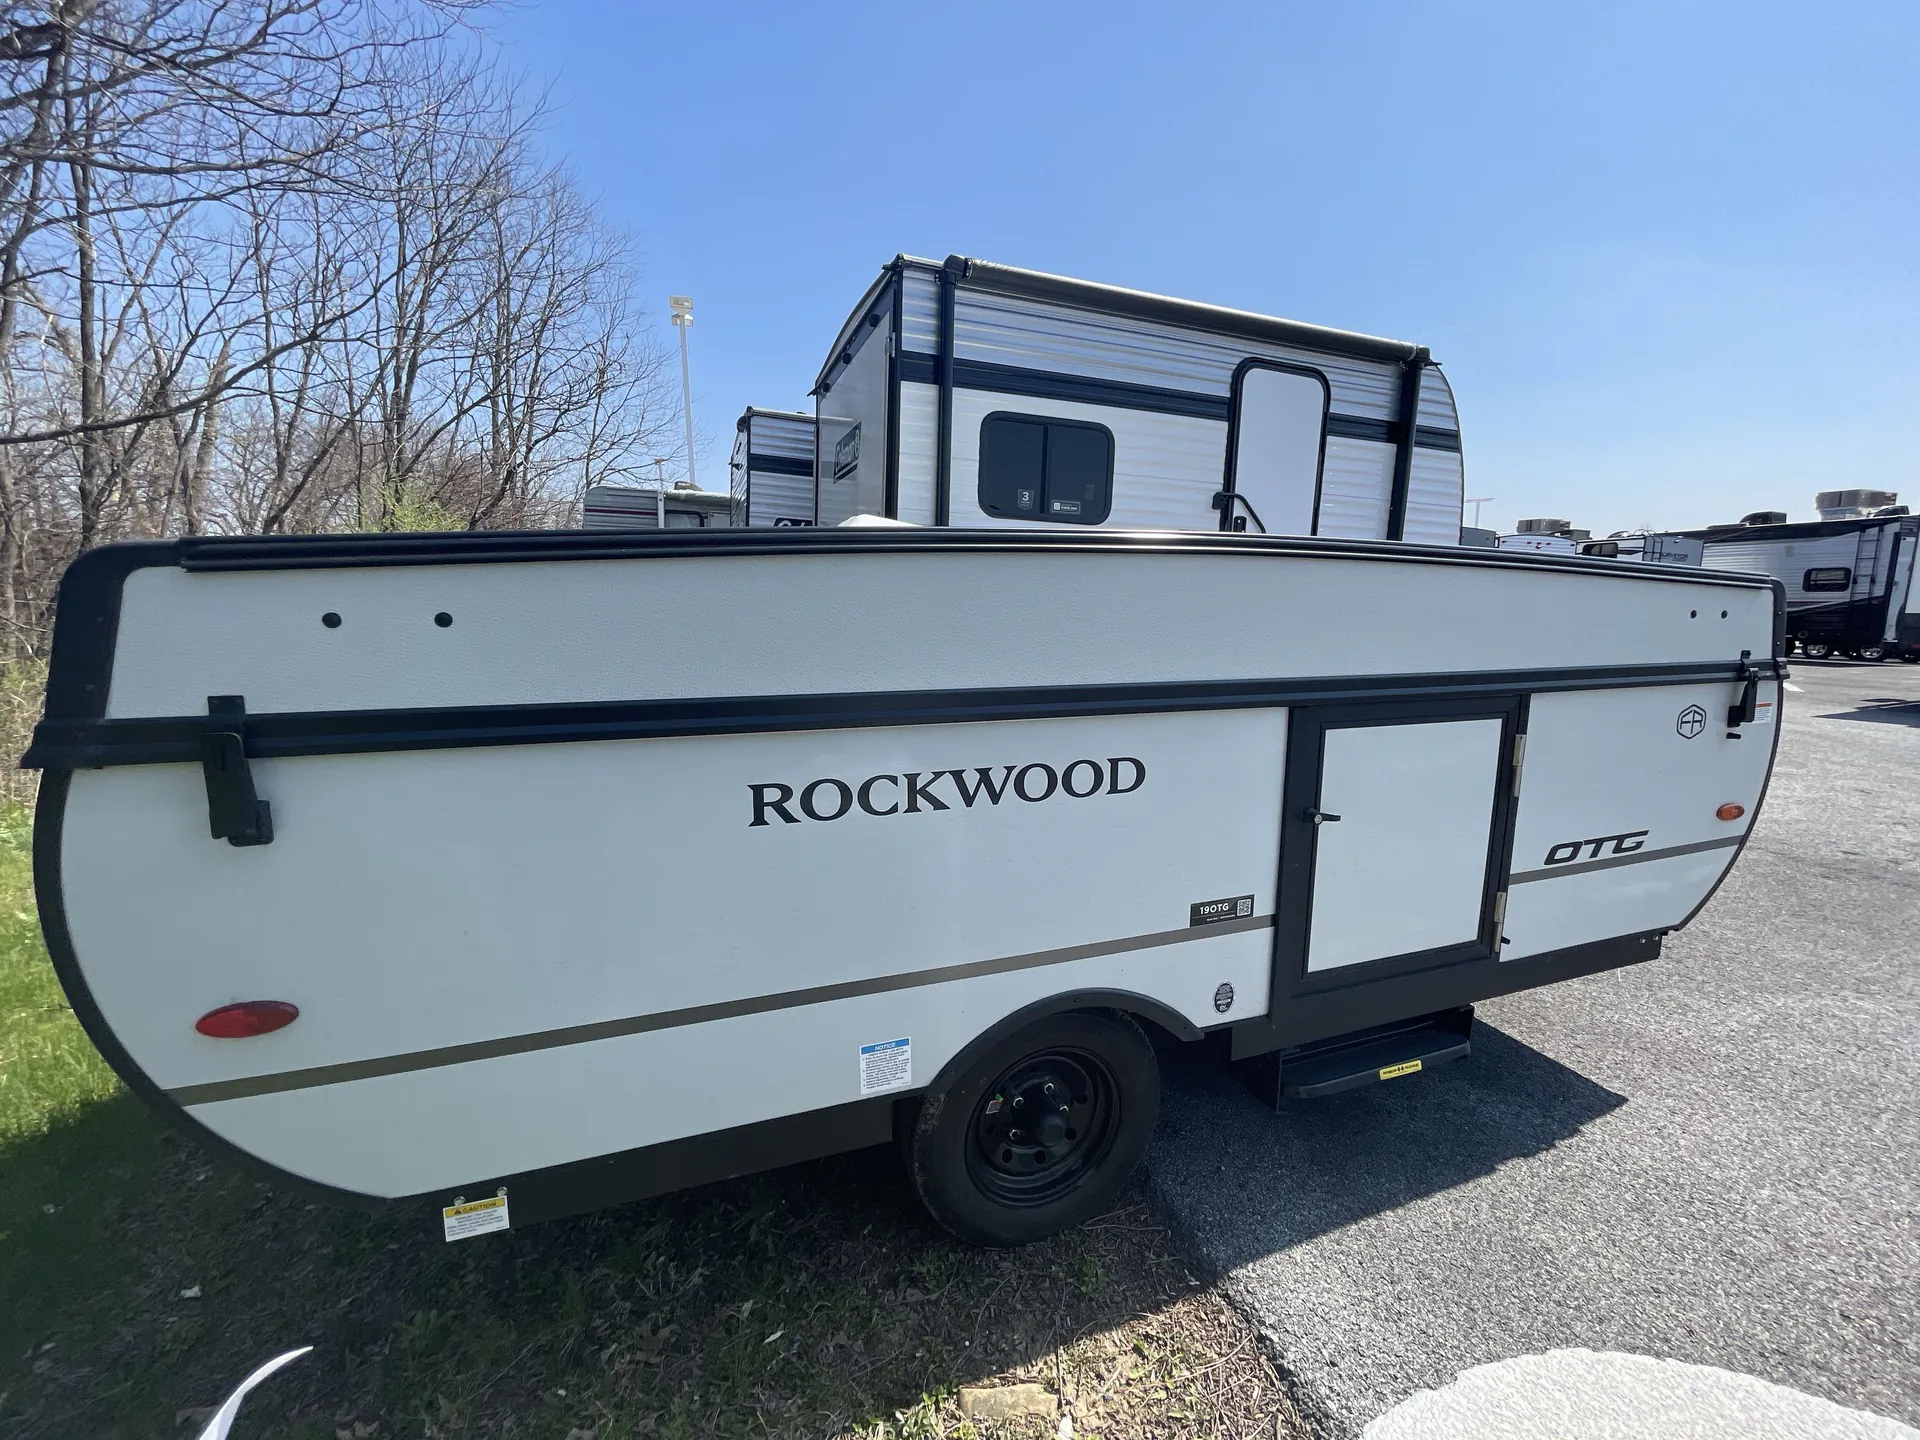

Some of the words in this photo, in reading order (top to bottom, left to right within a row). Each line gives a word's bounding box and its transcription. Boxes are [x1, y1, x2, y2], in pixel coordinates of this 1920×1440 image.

[1022, 491, 1030, 502] 3
[747, 757, 1146, 827] ROCKWOOD
[1543, 830, 1650, 866] OTG
[1199, 903, 1229, 915] 19OTG
[874, 1042, 897, 1051] NOTICE
[462, 1202, 497, 1213] CAUTION
